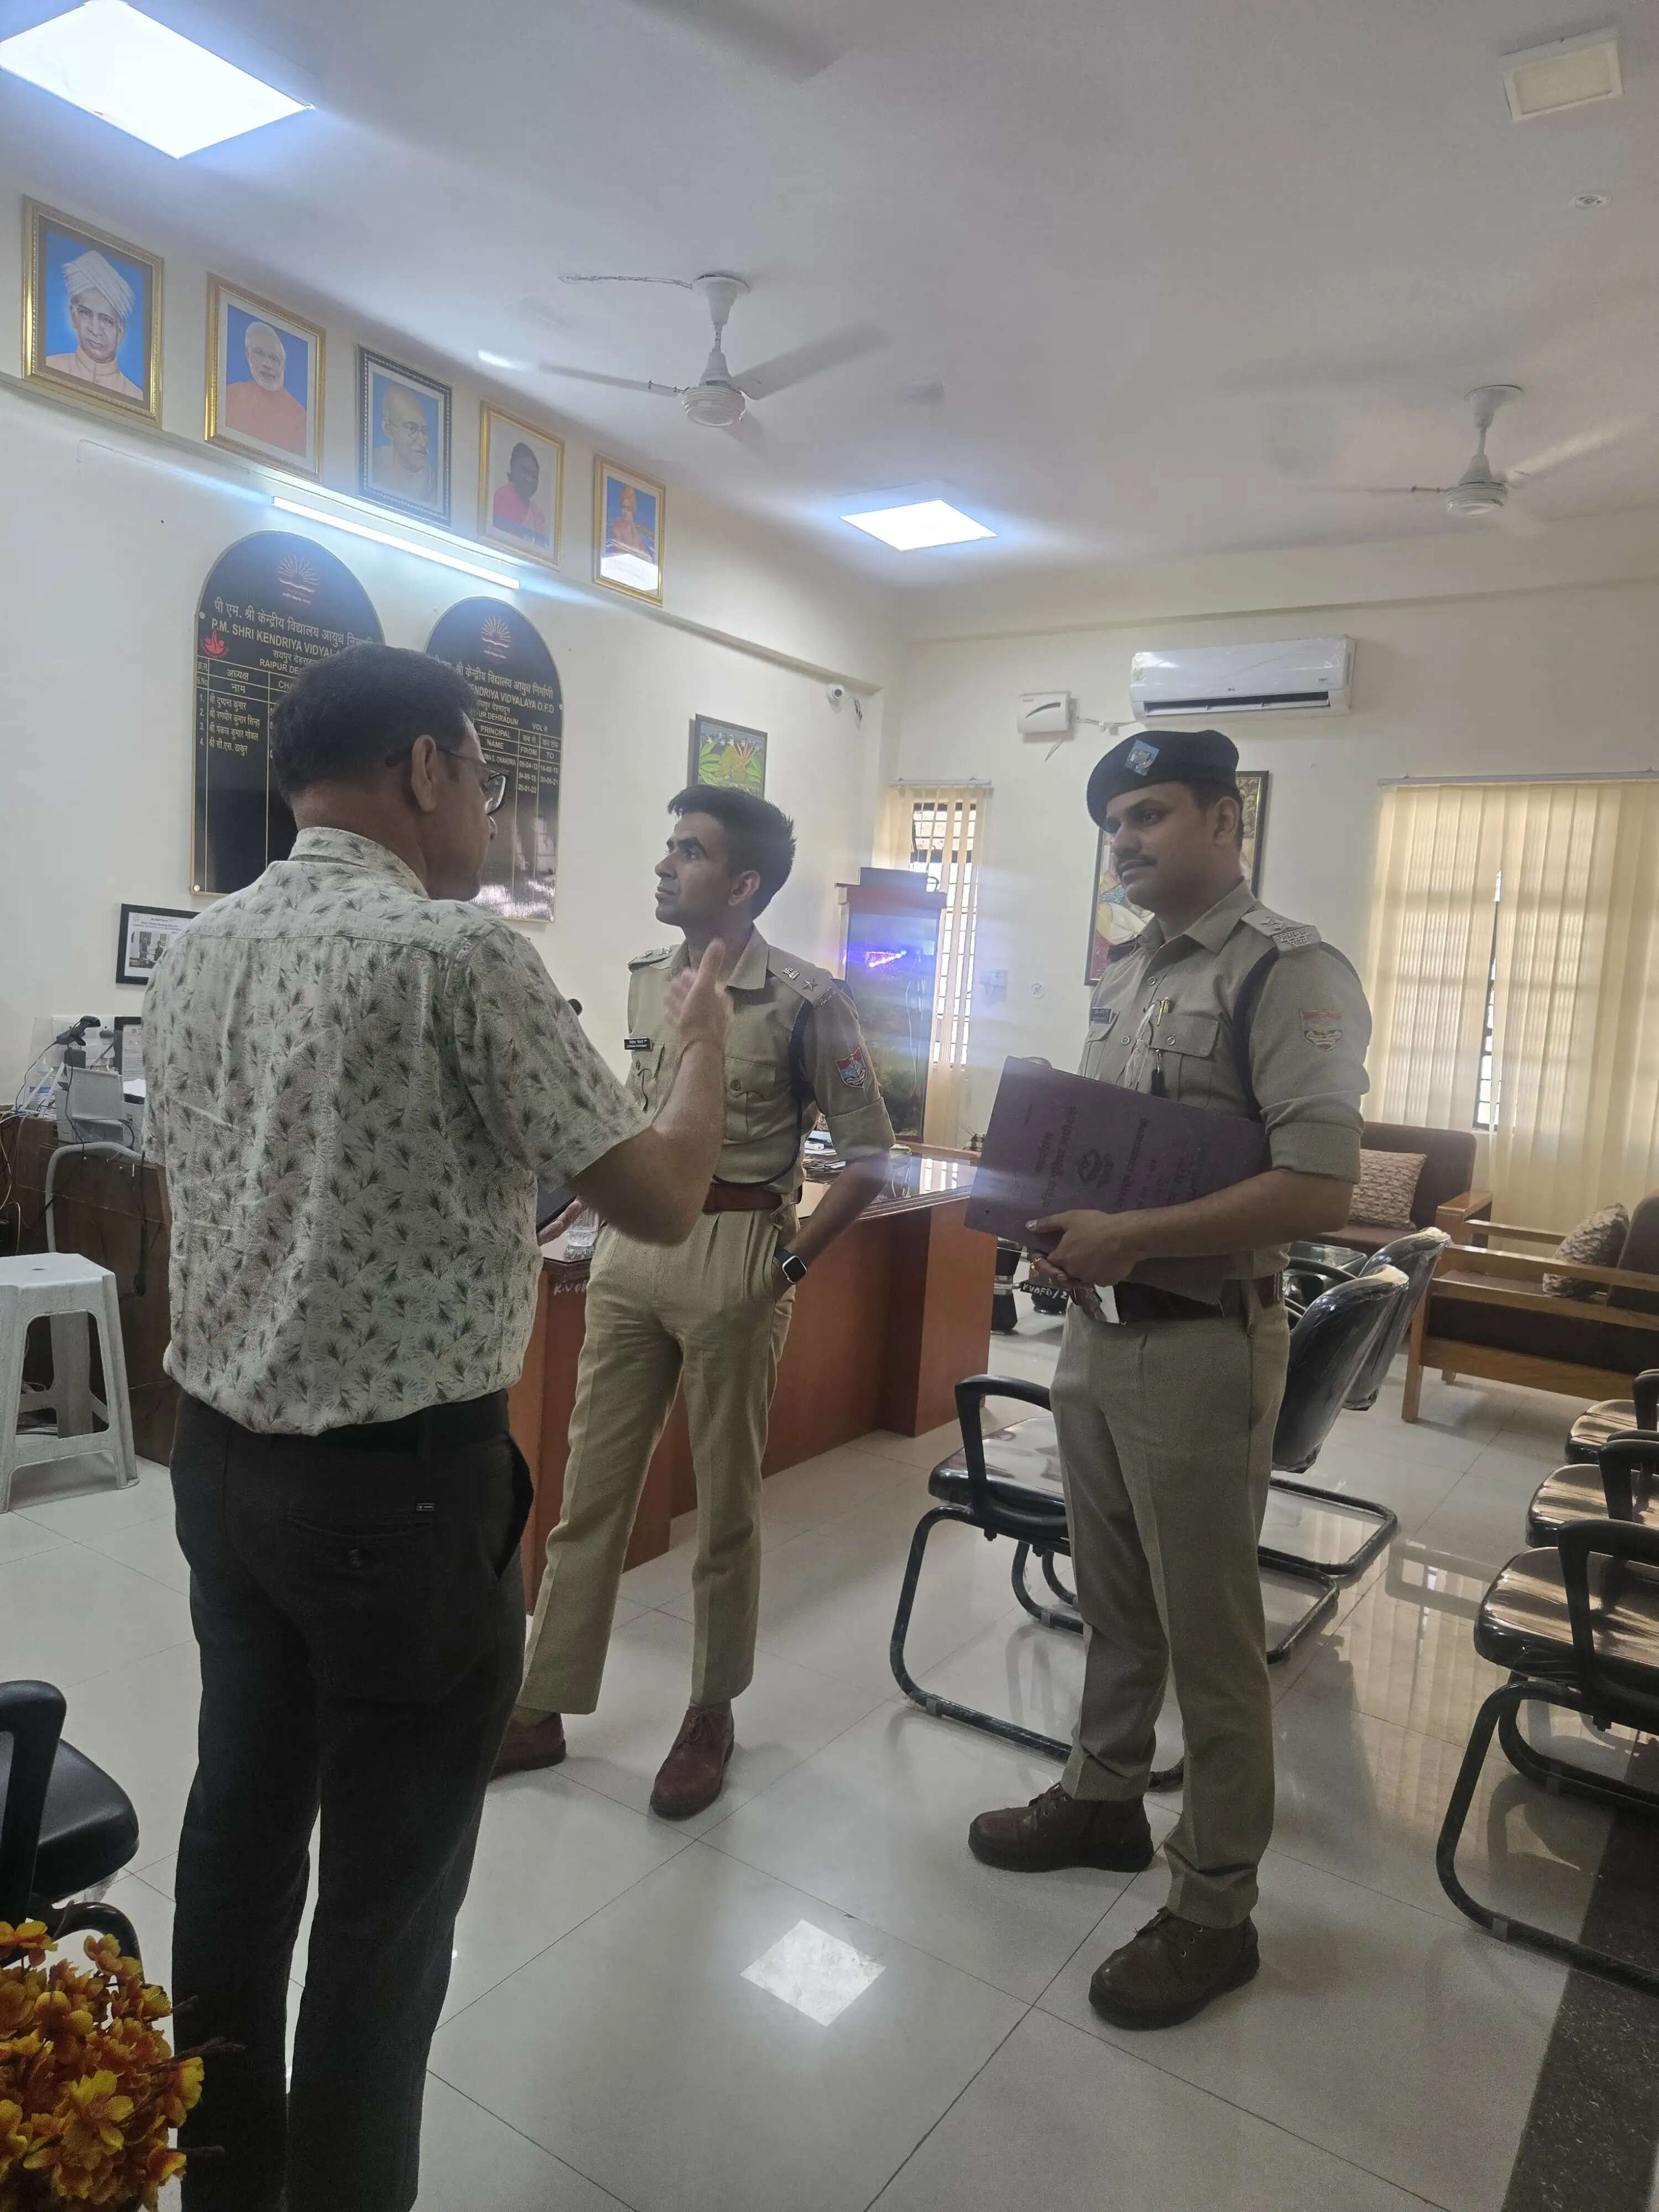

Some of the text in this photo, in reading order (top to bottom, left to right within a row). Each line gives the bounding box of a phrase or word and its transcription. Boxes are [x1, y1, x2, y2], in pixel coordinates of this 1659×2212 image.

[214, 597, 223, 613] पी
[244, 606, 254, 622] श्री
[258, 609, 284, 629] केन्द्रीय
[288, 617, 319, 638] विद्यालय
[212, 618, 229, 633] P.M.
[232, 624, 254, 640] SHRI
[257, 631, 302, 651] KENDRIYA
[273, 650, 292, 664] रायपुर
[259, 658, 288, 672] RAIPUR
[226, 669, 249, 681] अध्यक्ष
[465, 664, 486, 682] केन्द्रीय
[488, 670, 512, 688] विद्यालय
[514, 681, 531, 696] आयुध
[533, 682, 553, 699] निर्माणी
[231, 683, 246, 694] नाम
[233, 699, 247, 712] कुमार
[500, 691, 536, 709] VIDYALAYA
[233, 714, 247, 726] कुमार
[488, 712, 519, 726] DEHRADUN
[480, 725, 511, 739] PRINCIPAL
[532, 722, 542, 732] VOL
[230, 728, 243, 740] कुमार
[486, 739, 504, 749] NAME
[520, 746, 538, 757] FROM
